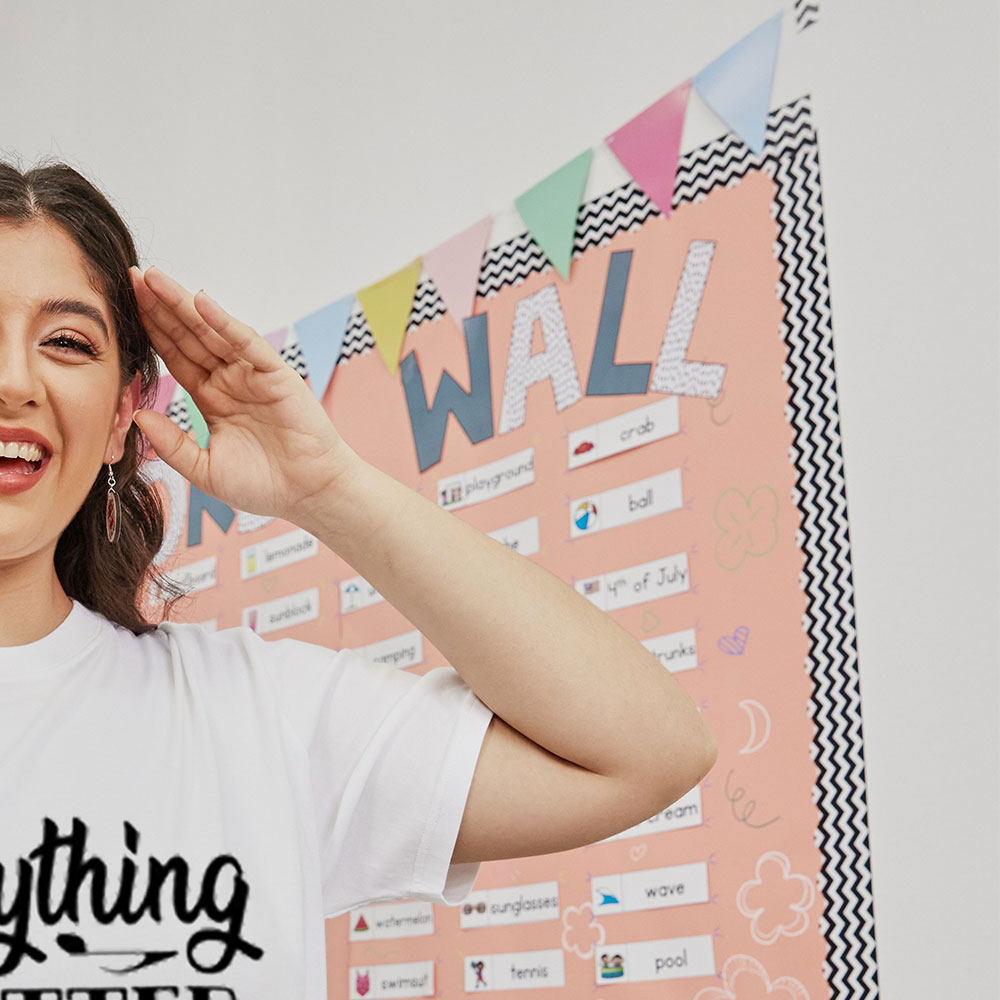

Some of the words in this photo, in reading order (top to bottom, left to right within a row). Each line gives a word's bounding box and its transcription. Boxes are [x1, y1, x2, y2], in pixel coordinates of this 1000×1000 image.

[399, 240, 728, 474] WALL
[619, 416, 655, 442] crab
[464, 454, 535, 496] playground
[628, 489, 654, 512] ball
[265, 537, 313, 563] lemonade
[634, 571, 649, 593] of
[656, 564, 689, 587] July
[269, 602, 313, 625] sunblock
[648, 804, 698, 824] ream
[644, 882, 686, 900] wave
[490, 894, 559, 917] sunglasses
[375, 912, 433, 929] watermelon
[655, 948, 688, 974] pool
[511, 965, 549, 981] tennis
